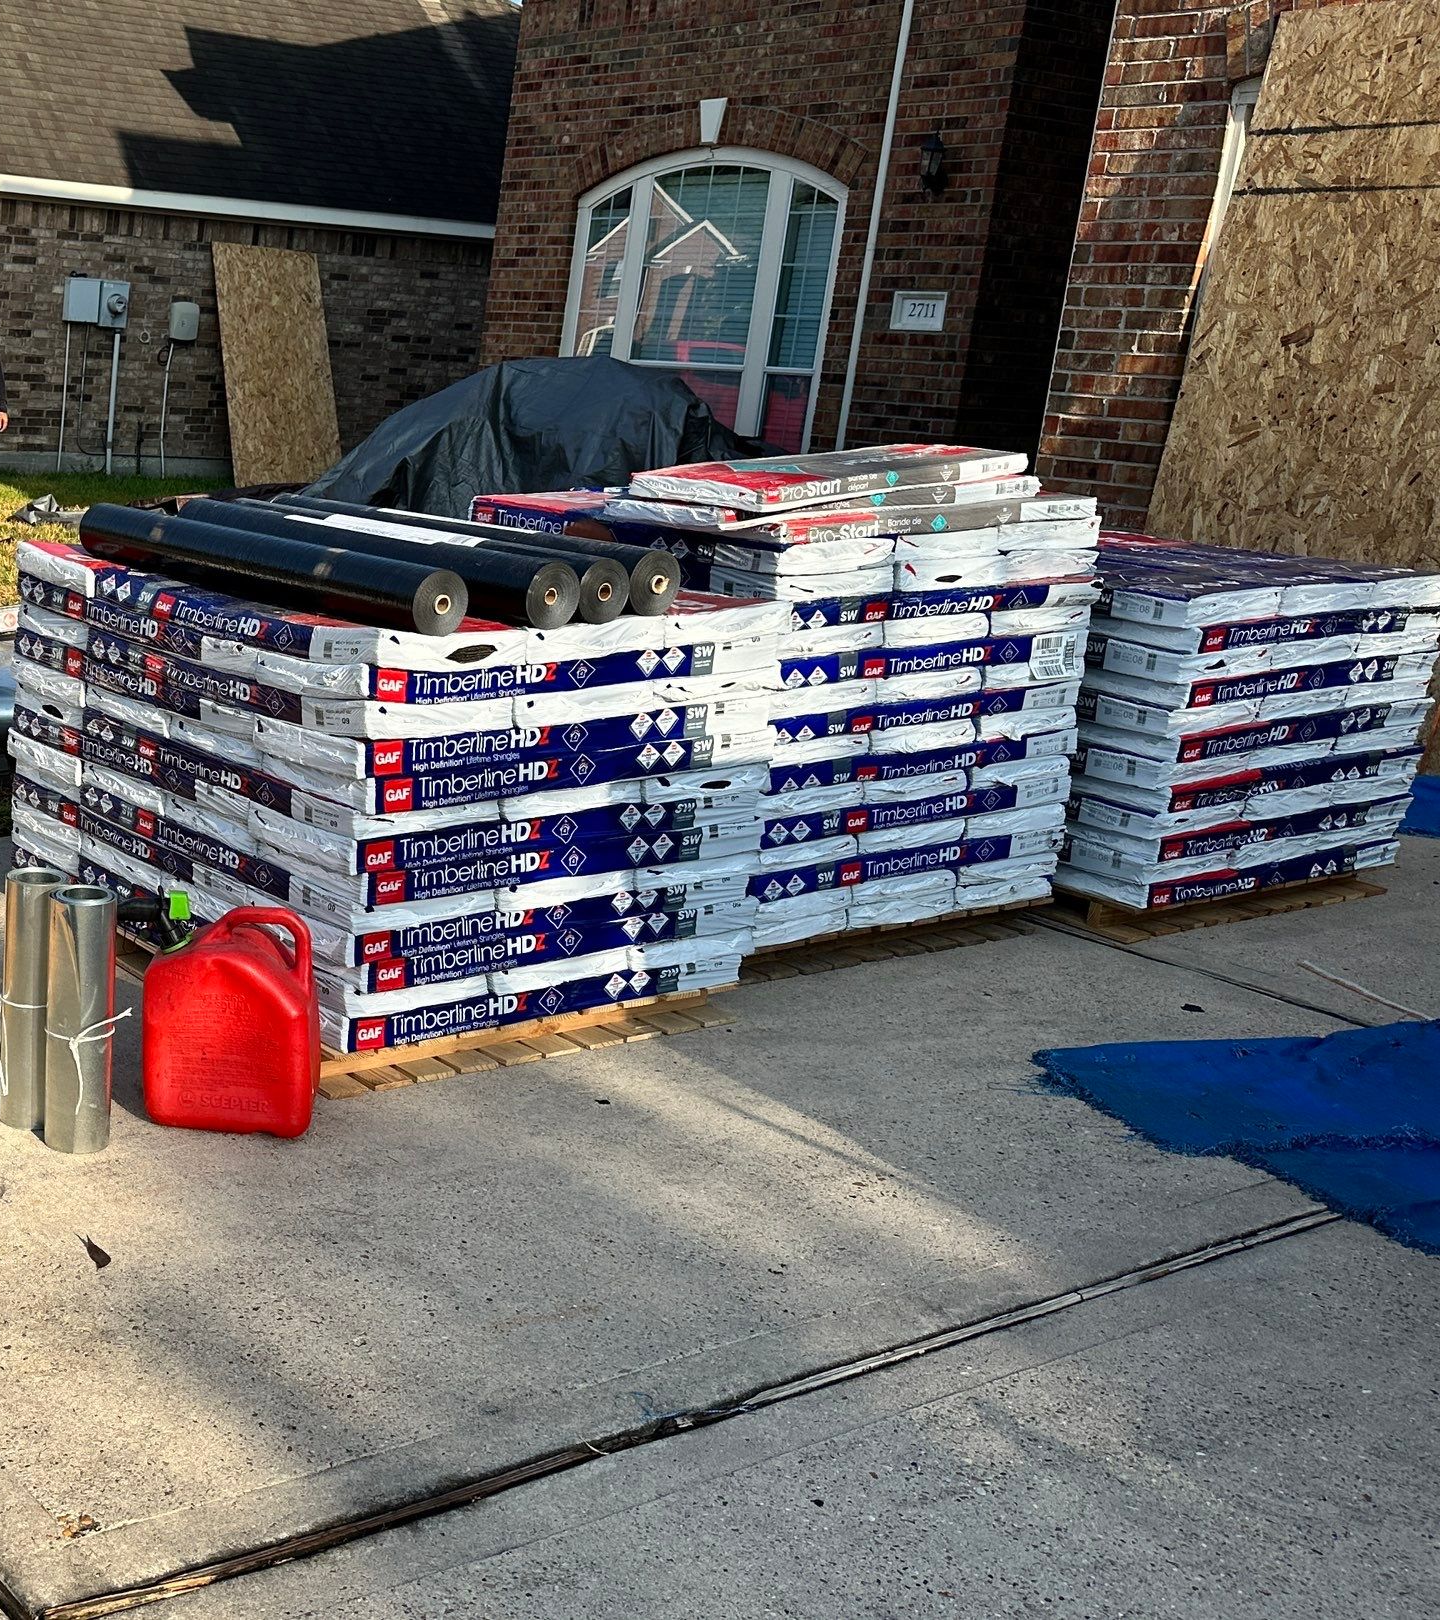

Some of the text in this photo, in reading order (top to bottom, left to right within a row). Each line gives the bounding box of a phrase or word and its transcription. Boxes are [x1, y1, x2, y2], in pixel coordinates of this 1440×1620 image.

[908, 303, 936, 318] 2711
[156, 601, 171, 612] GAF
[866, 610, 884, 620] GAF
[694, 646, 714, 657] SW
[865, 666, 884, 676] GAF
[379, 679, 404, 691] GAF
[1195, 694, 1211, 703] GAF
[687, 706, 707, 719] SW
[853, 723, 871, 732] GAF
[694, 741, 712, 752] SW
[375, 752, 400, 764] GAF
[386, 788, 410, 801] GAF
[848, 817, 866, 828] GAF
[682, 835, 702, 845] SW
[367, 852, 392, 865] GAF
[842, 870, 859, 881] GAF
[377, 880, 403, 892] GAF
[667, 885, 686, 895] SW
[678, 911, 695, 919] SW
[364, 941, 388, 954] GAF
[378, 967, 402, 981] GAF
[358, 1027, 382, 1041] GAF
